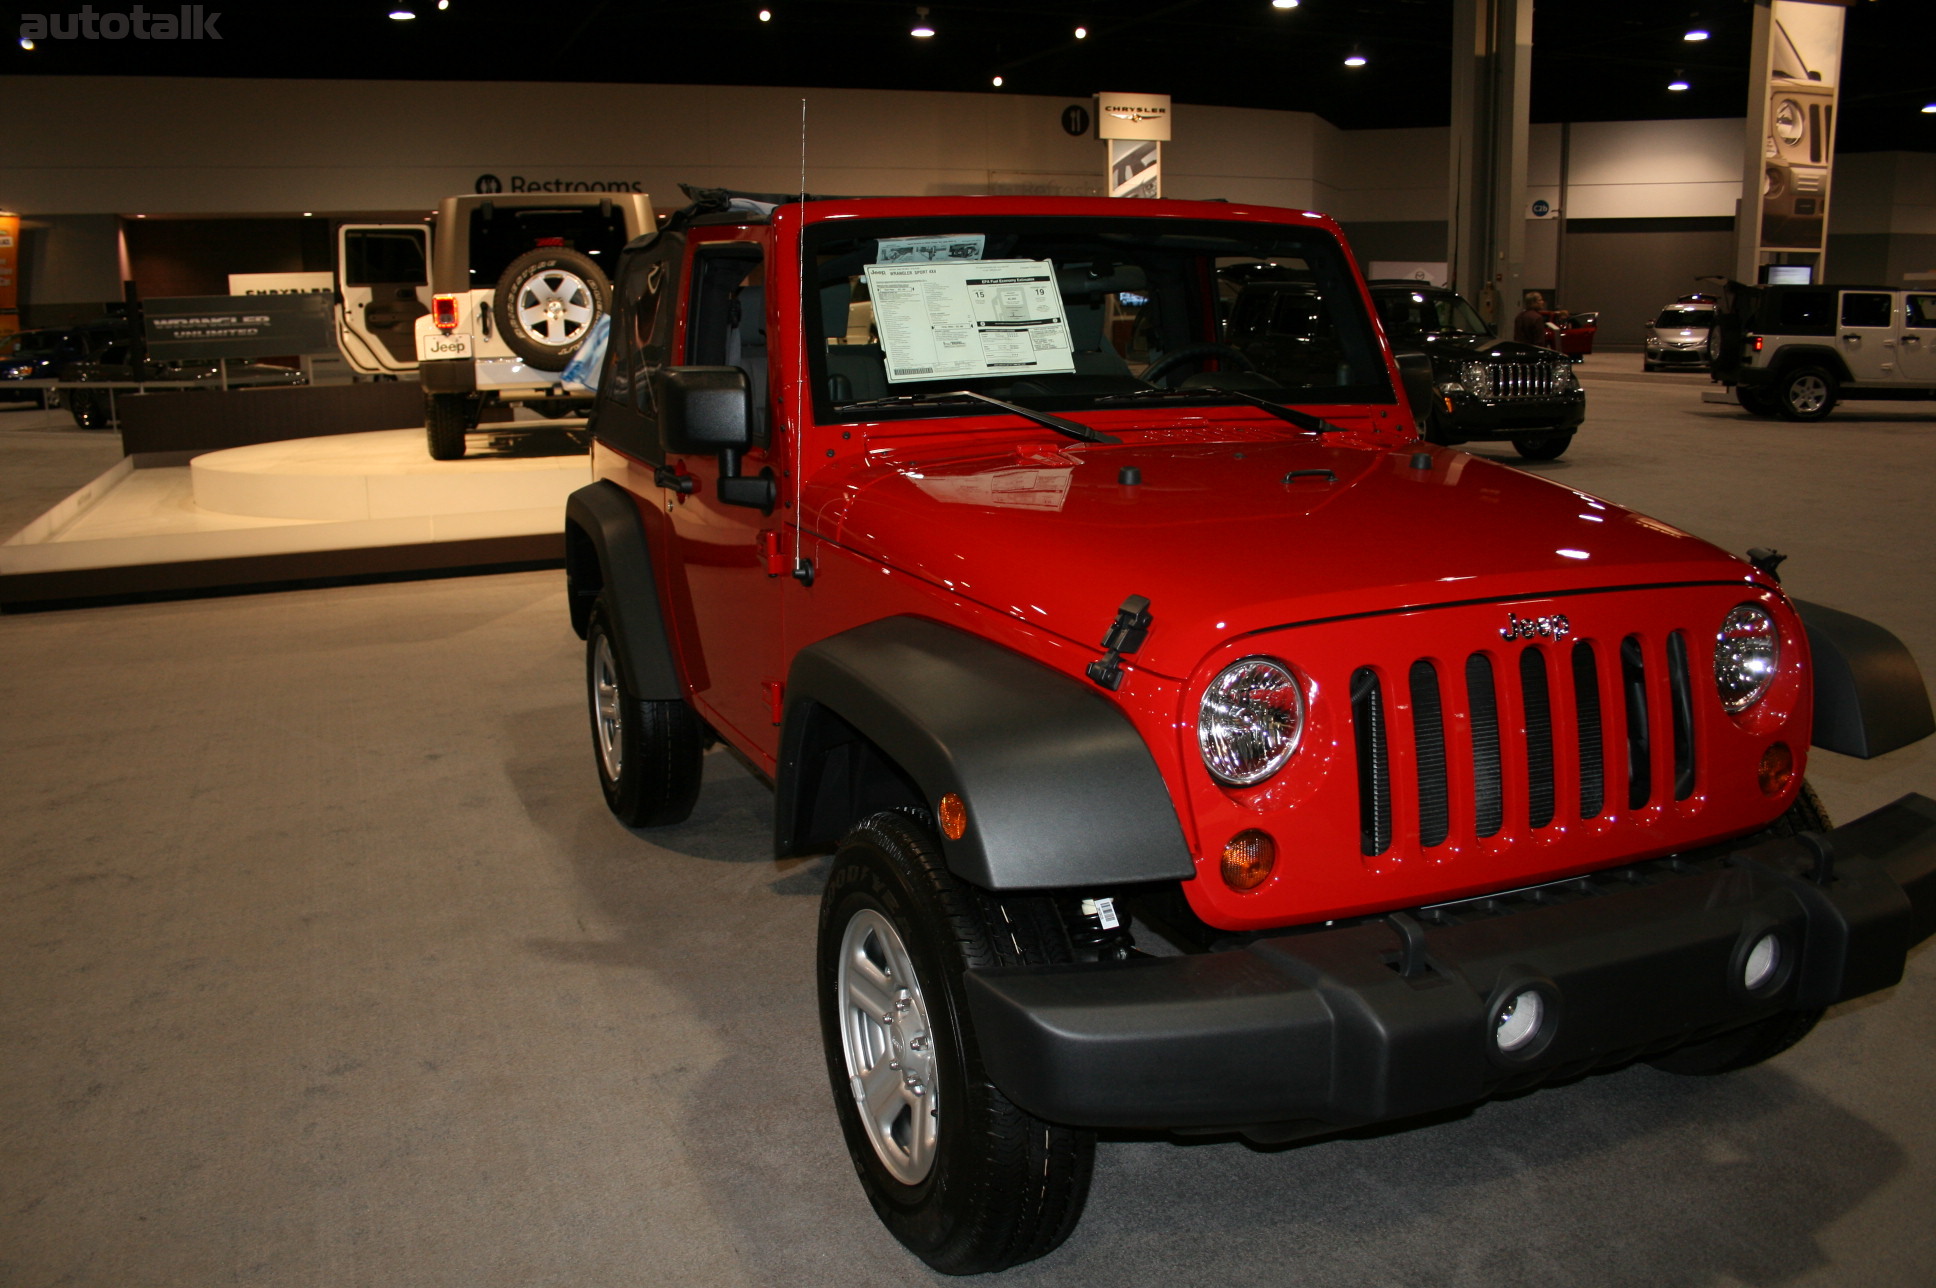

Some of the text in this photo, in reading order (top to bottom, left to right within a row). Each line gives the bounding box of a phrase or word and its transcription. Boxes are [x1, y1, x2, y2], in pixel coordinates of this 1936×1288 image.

[1105, 105, 1166, 113] CHRYSLER
[511, 175, 643, 194] Restrooms
[153, 315, 271, 329] WRANGLER
[173, 328, 259, 339] UNLIMITED
[430, 341, 465, 354] Jeep
[1499, 612, 1570, 642] Jeep
